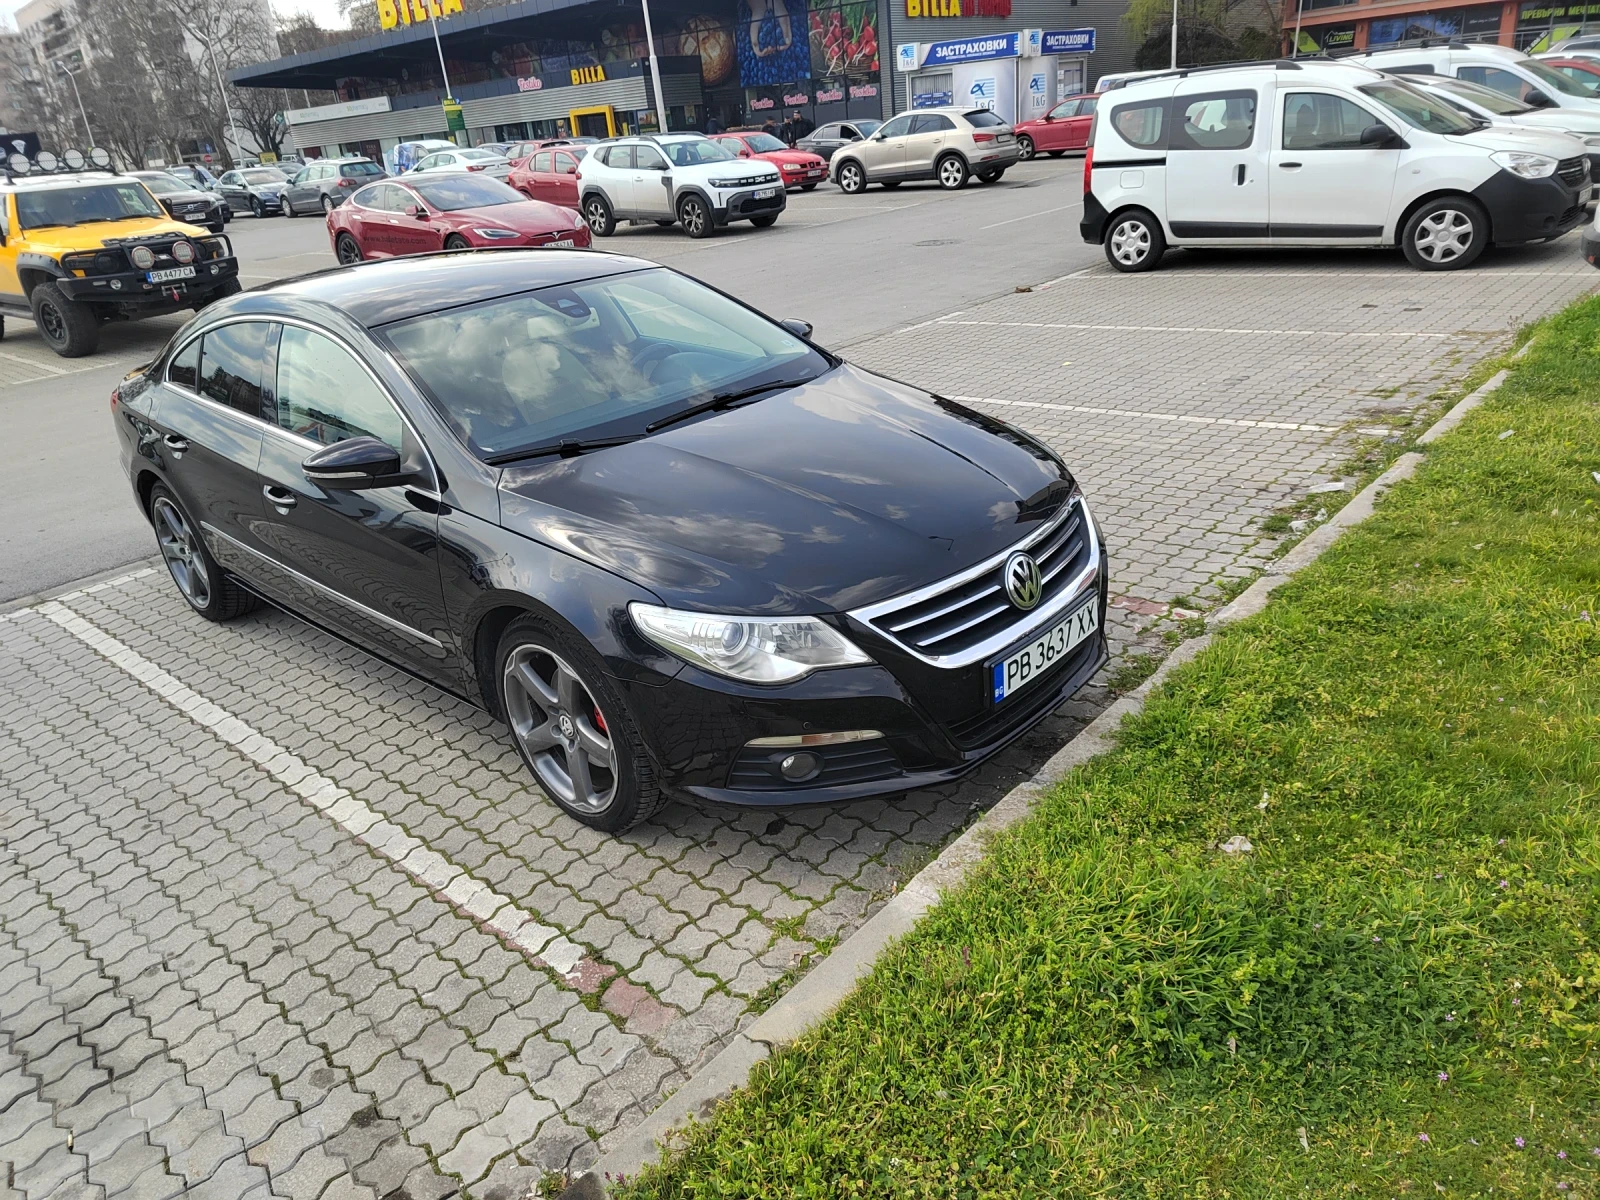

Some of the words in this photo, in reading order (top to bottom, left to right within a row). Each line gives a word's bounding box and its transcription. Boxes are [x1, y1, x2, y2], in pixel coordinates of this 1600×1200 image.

[907, 0, 960, 17] BILLA
[1568, 4, 1600, 15] МЕЧТАТ
[1046, 34, 1089, 46] ЗАСТРАХОВКИ
[1329, 33, 1354, 42] LIVING
[935, 38, 1007, 57] ЗАСТРАХОВКИ
[570, 65, 605, 85] BILLA
[1032, 95, 1046, 107] I&G
[152, 272, 162, 280] PB
[164, 269, 182, 279] 4477
[184, 268, 194, 276] CA
[1007, 651, 1032, 690] PB
[1036, 617, 1072, 670] 3637
[1077, 601, 1095, 639] XX
[994, 686, 1004, 698] BG
